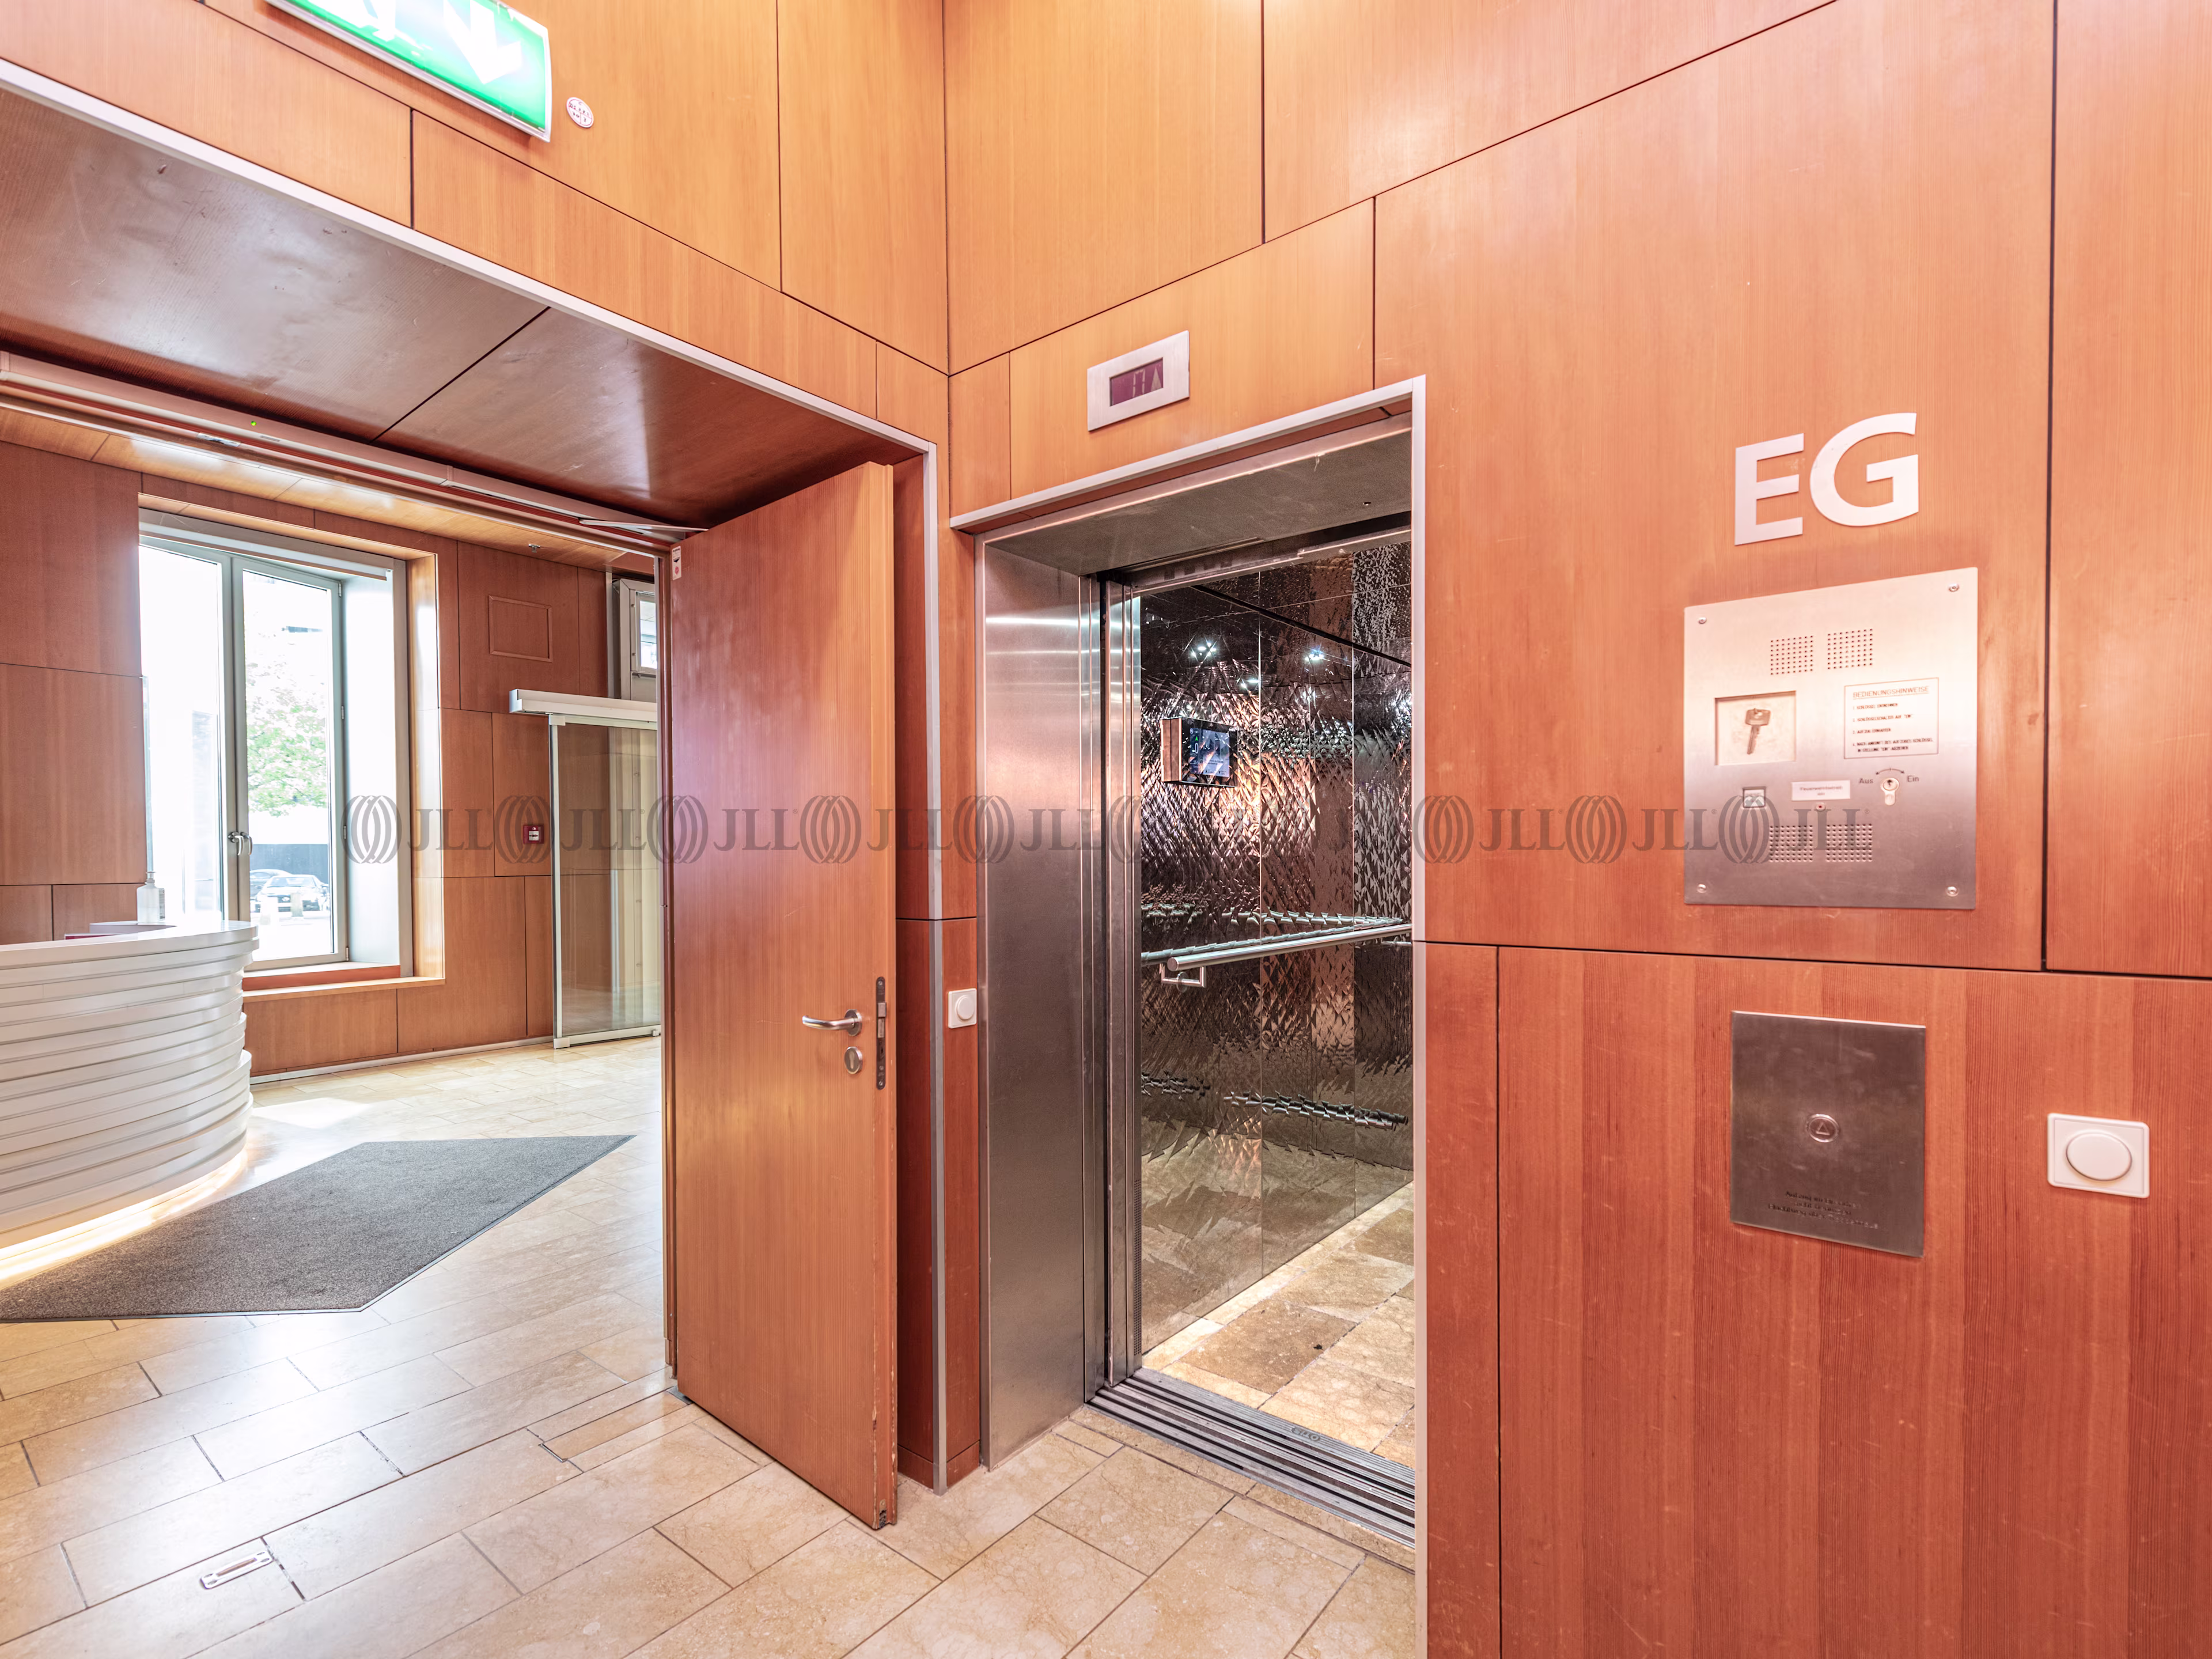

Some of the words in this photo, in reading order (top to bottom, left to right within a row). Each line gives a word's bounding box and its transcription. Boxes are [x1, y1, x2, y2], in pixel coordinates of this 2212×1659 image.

[1735, 412, 1919, 546] EG
[1853, 685, 1929, 698] BEDIENUNGSHINWEISE
[1907, 775, 1920, 783] Ein
[1293, 1428, 1319, 1441] OTIS
